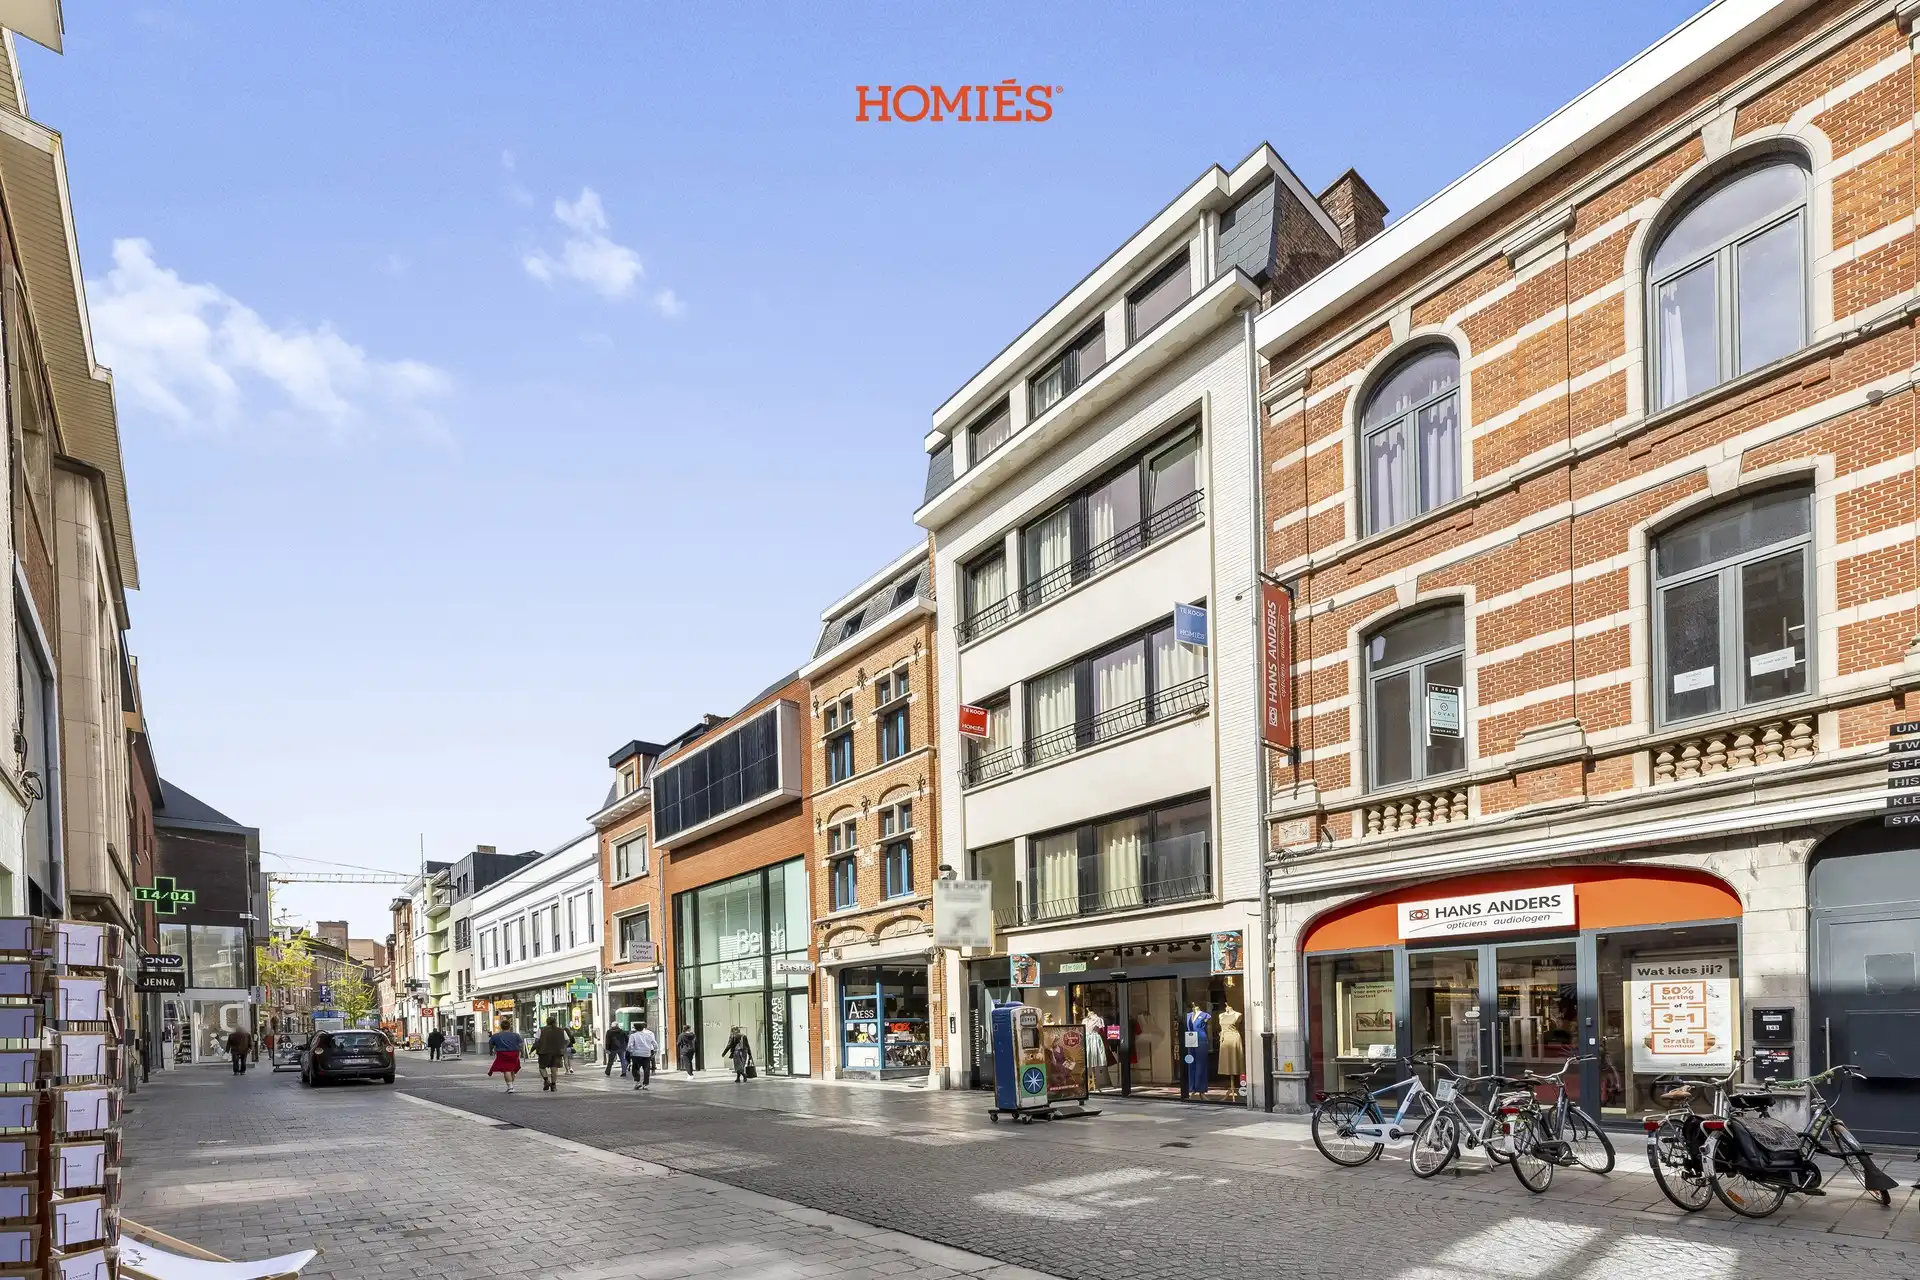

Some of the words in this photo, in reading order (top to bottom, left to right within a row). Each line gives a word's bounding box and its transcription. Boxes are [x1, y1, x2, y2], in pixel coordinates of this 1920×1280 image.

[1187, 608, 1204, 617] KOOP
[1267, 600, 1277, 660] ANDERS
[1268, 661, 1278, 703] HANS
[969, 708, 985, 716] KOOP
[1432, 710, 1455, 718] COVAS
[140, 889, 190, 901] 14/04
[1435, 903, 1482, 919] HANS
[1486, 894, 1561, 914] ANDERS
[1446, 919, 1488, 930] opticiens
[1493, 913, 1551, 925] audiologen
[631, 943, 652, 951] Vintage
[1637, 967, 1664, 976] Wat
[1668, 966, 1698, 975] kies
[1701, 964, 1723, 976] jij?
[143, 978, 176, 987] JENNA
[1662, 986, 1694, 995] 50%
[1662, 1013, 1695, 1023] 3=1
[771, 997, 780, 1068] MENSWEAR
